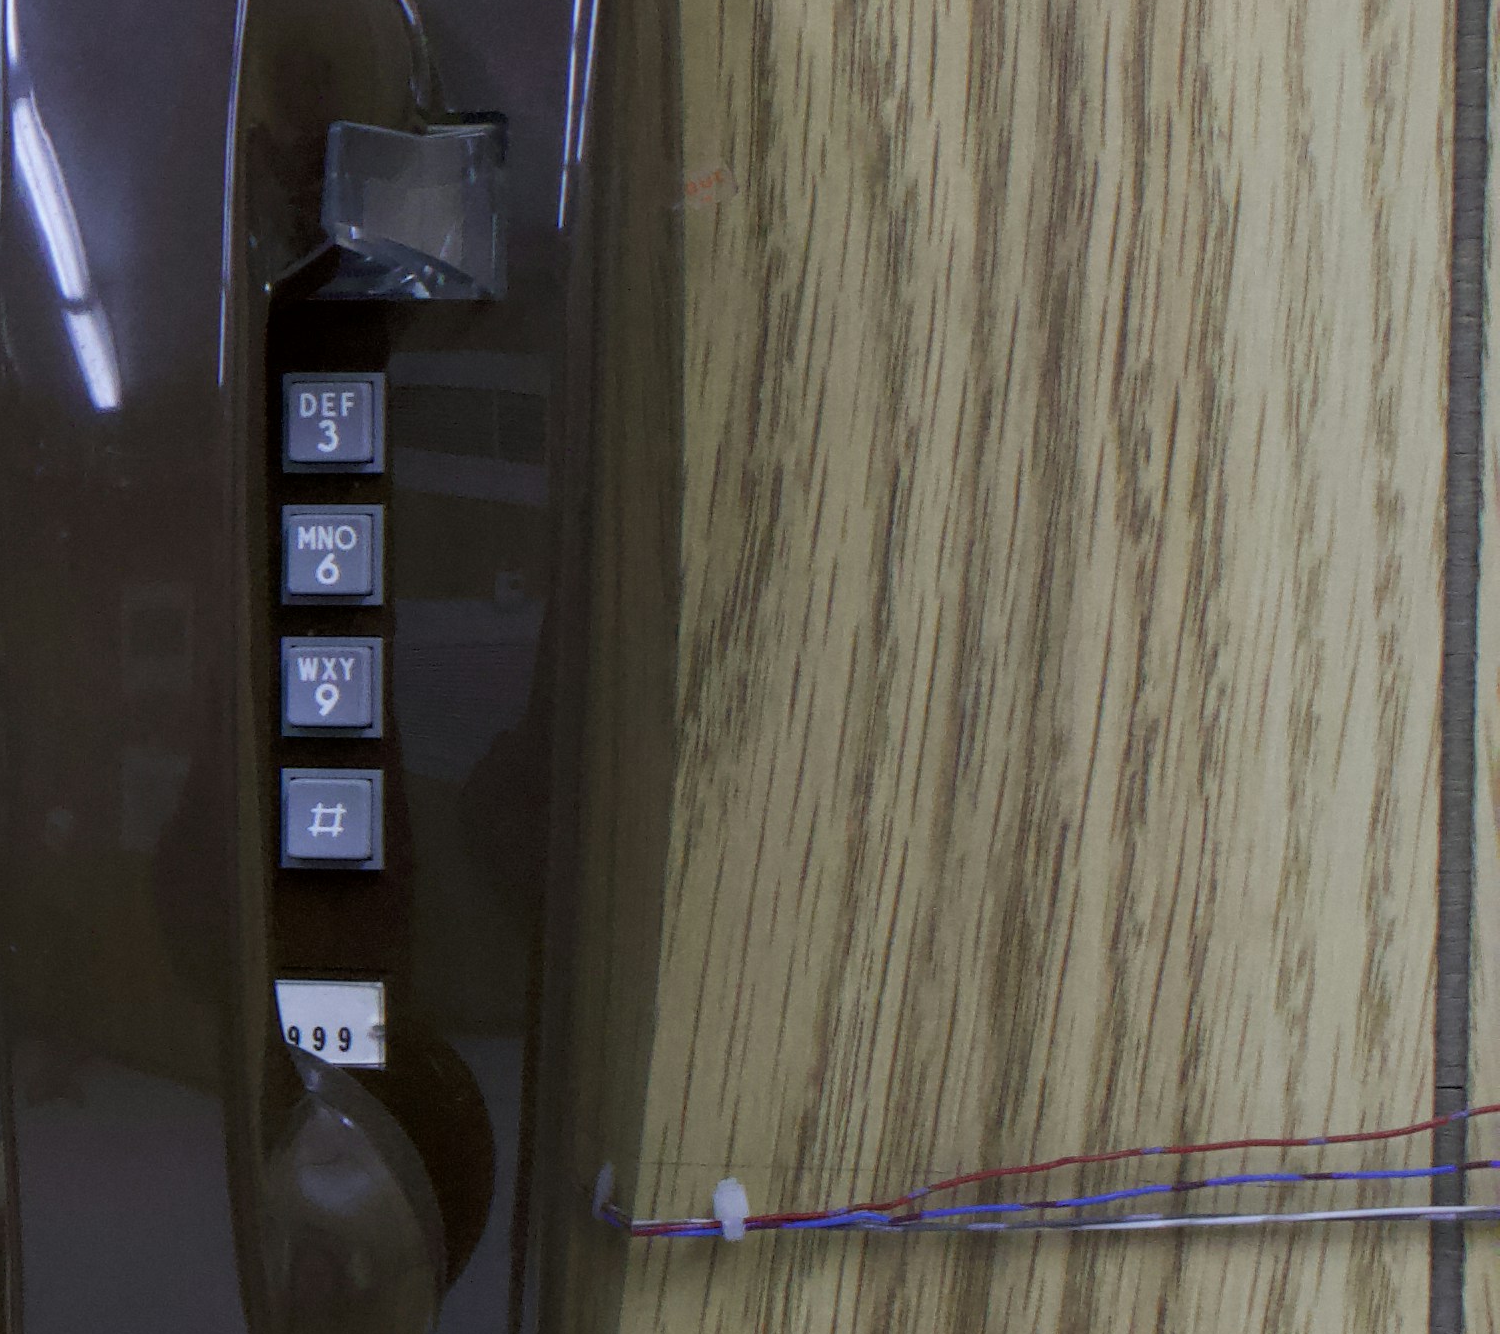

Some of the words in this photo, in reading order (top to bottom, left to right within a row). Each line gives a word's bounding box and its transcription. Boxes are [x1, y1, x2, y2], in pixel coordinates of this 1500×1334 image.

[298, 392, 355, 418] DEF
[317, 420, 339, 452] 3
[297, 525, 357, 550] MNO
[316, 552, 340, 585] 6
[297, 657, 355, 681] WXY
[314, 683, 339, 716] 9
